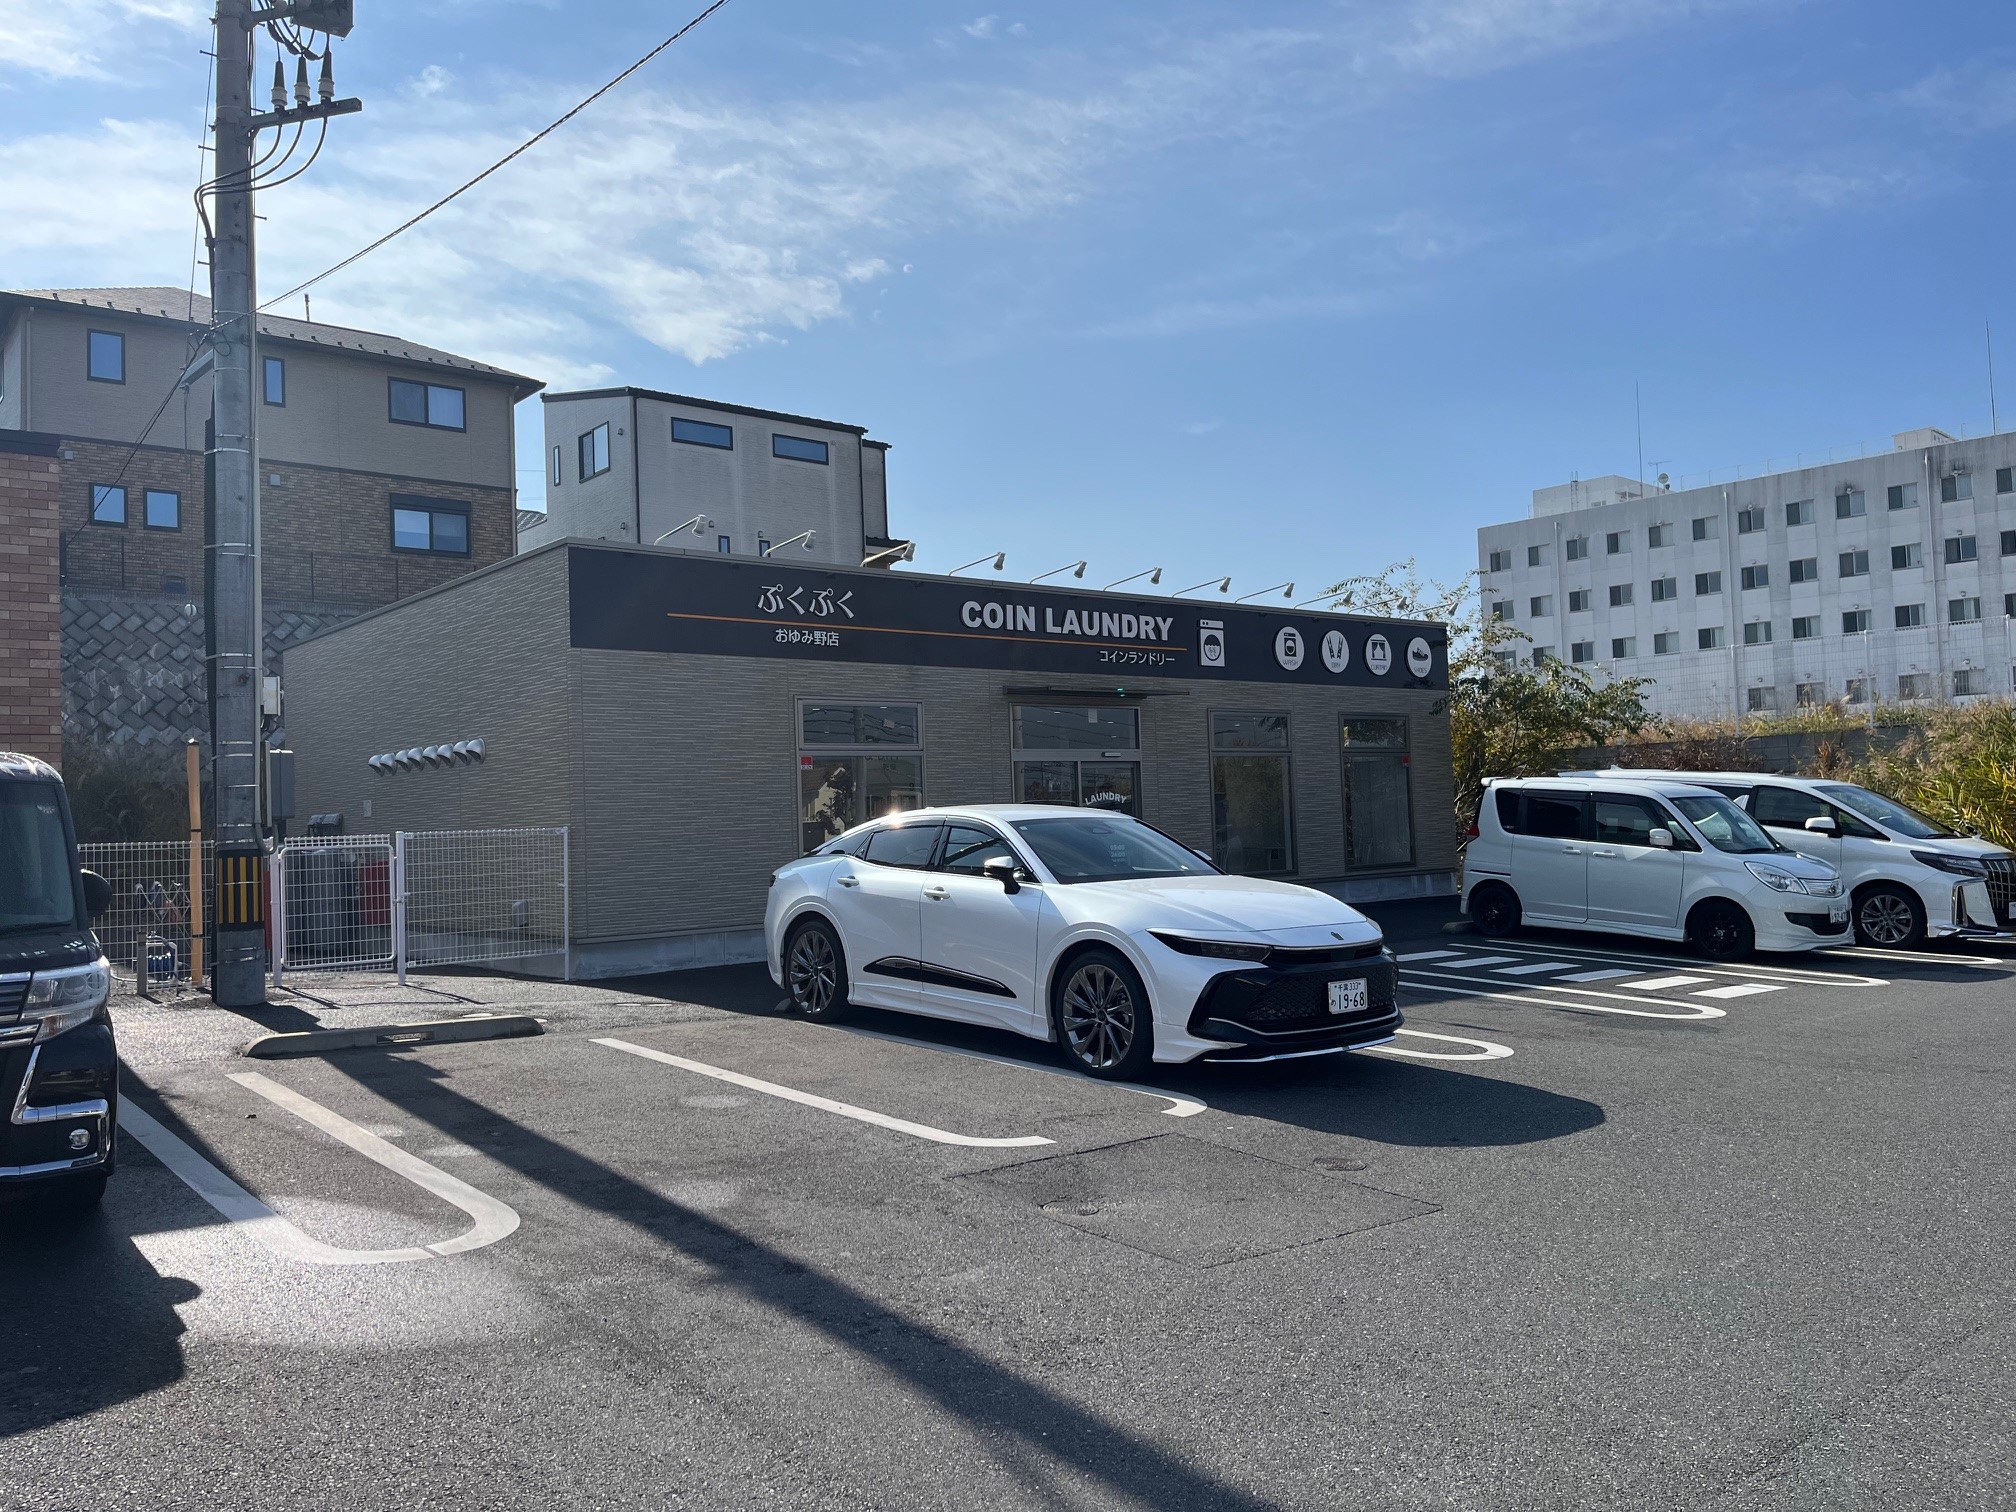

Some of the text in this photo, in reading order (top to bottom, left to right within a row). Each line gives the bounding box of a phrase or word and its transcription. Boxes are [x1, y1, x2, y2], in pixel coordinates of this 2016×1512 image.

[757, 583, 855, 619] ぷくぷく
[961, 600, 1174, 642] COIN LAUNDRY
[775, 628, 839, 647] おゆみ野店
[1099, 649, 1176, 667] コインランドリー
[1085, 792, 1127, 805] LAUNDRY
[1349, 982, 1359, 991] 333
[1338, 991, 1364, 1009] 19-68
